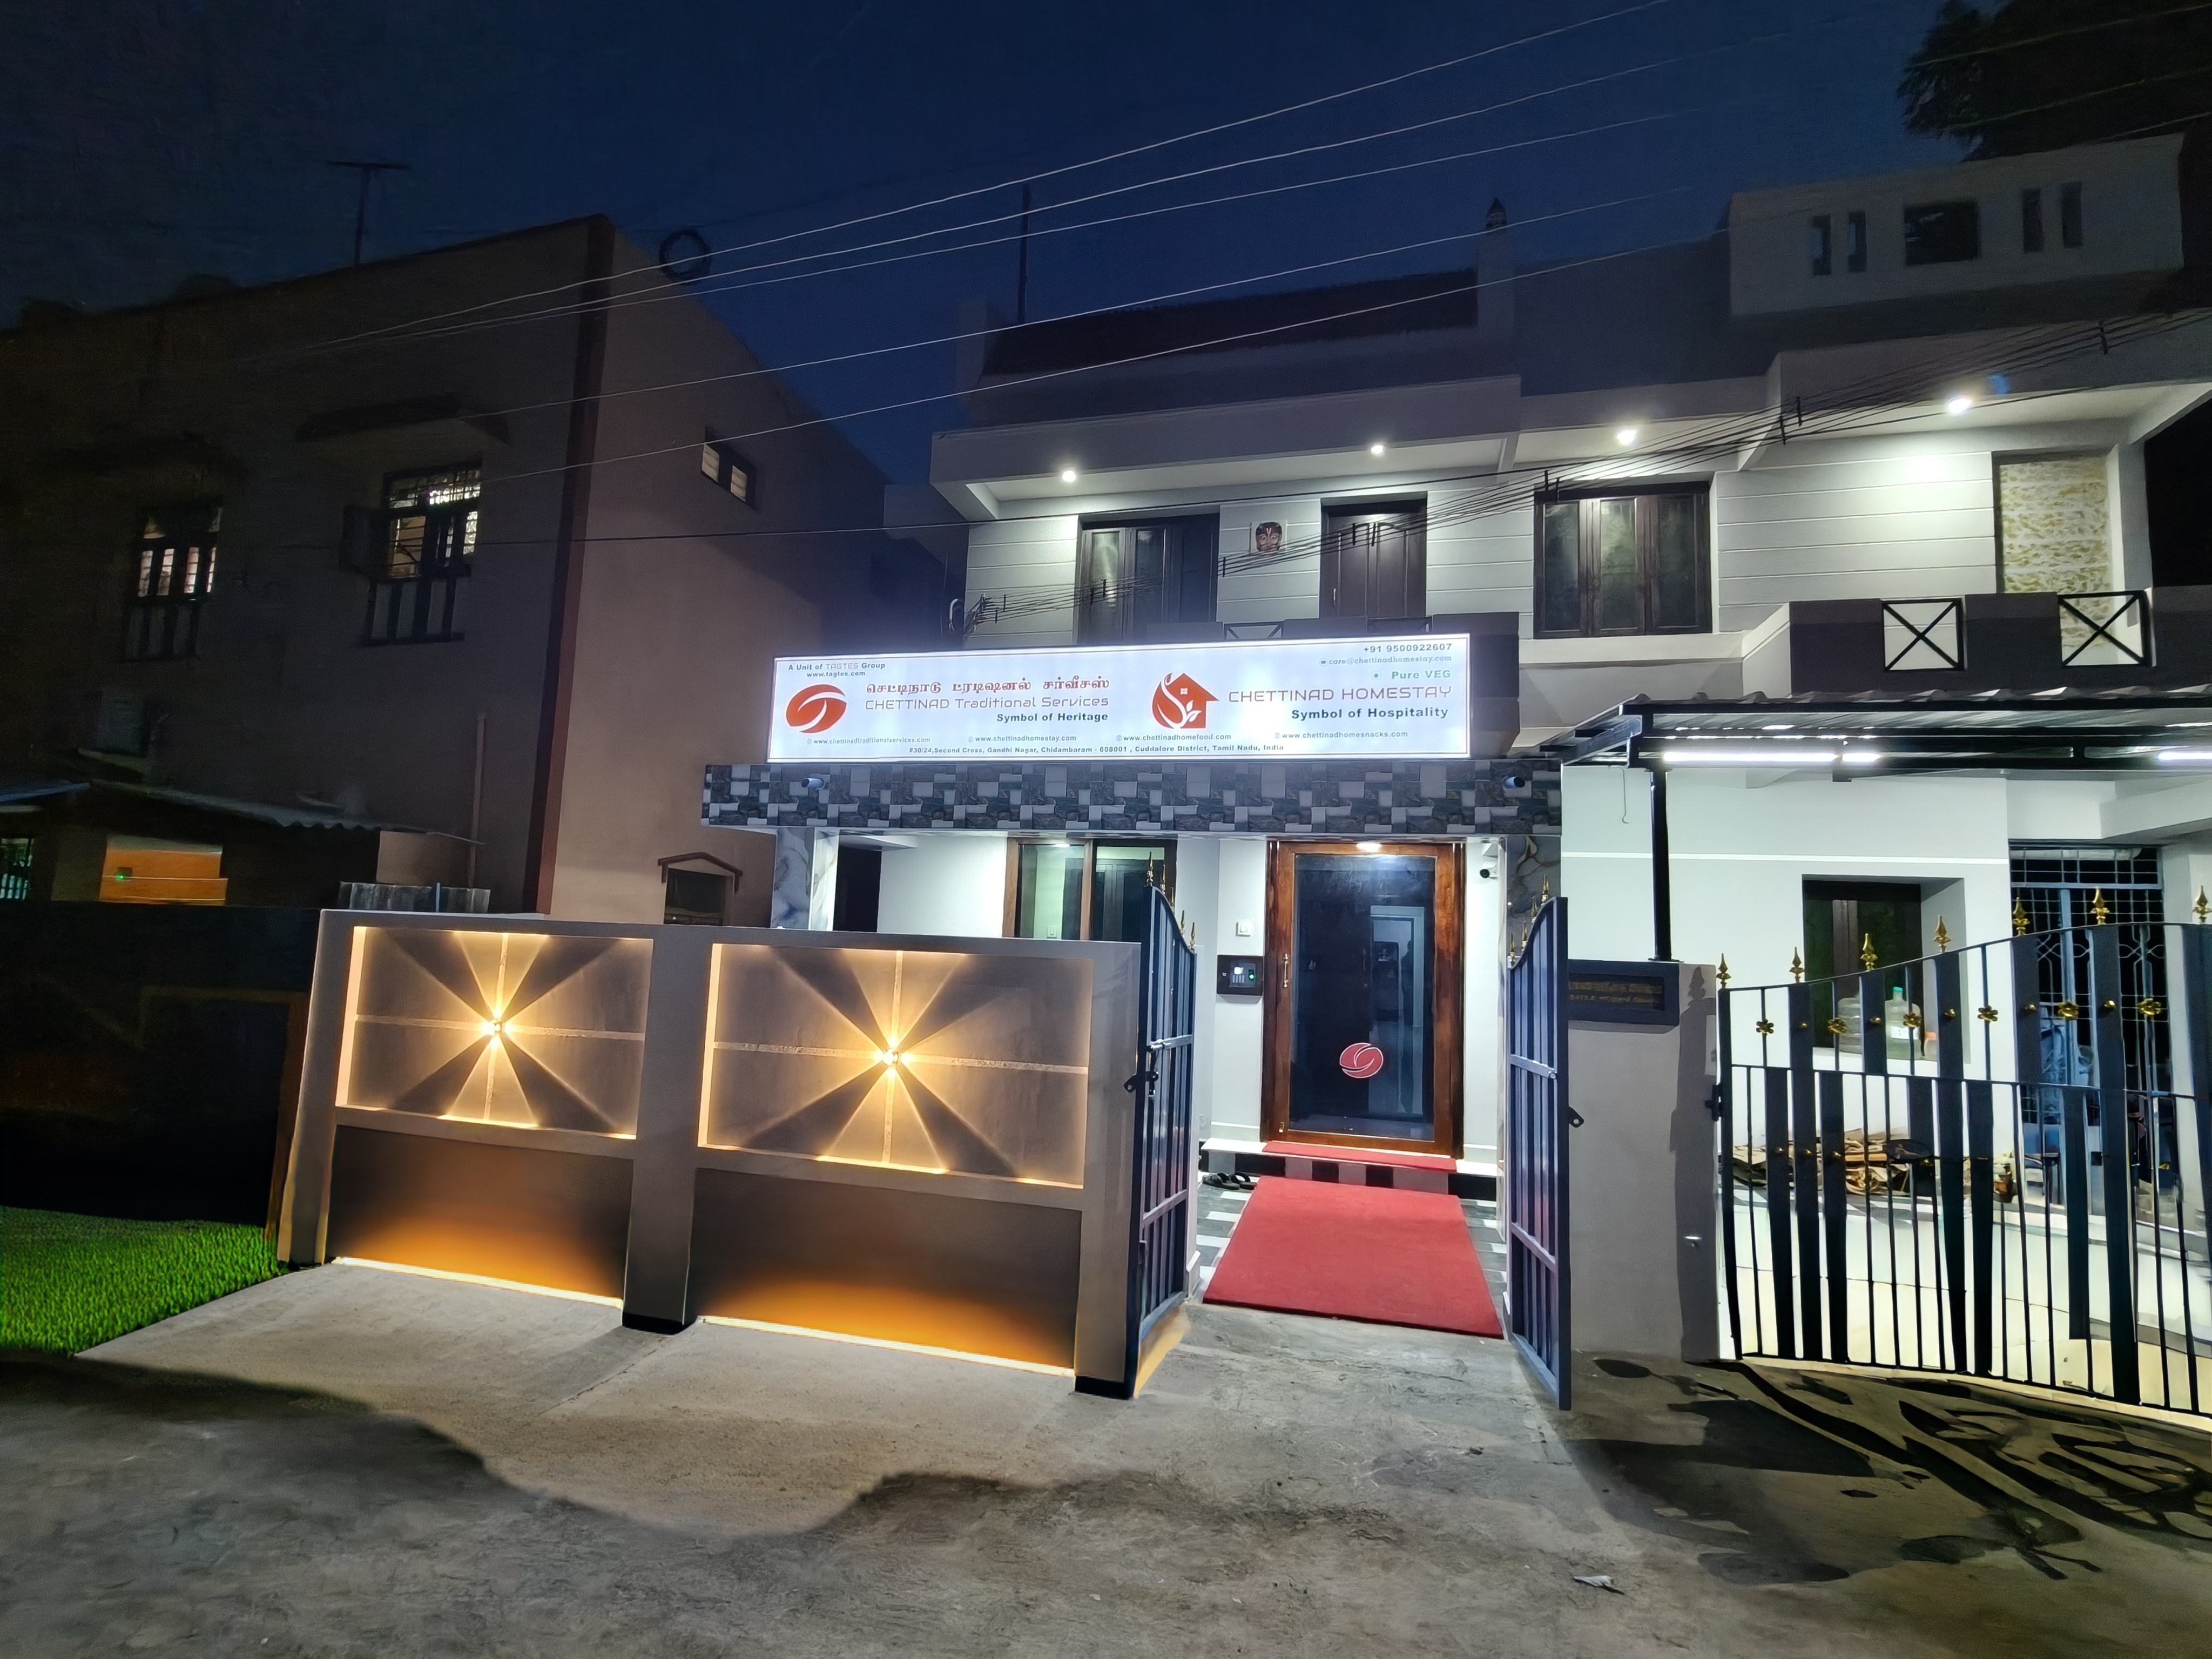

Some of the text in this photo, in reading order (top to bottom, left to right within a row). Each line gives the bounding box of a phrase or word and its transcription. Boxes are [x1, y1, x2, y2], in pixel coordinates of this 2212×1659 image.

[1386, 643, 1452, 652] 9500922607
[1425, 670, 1451, 678] VEG
[1228, 686, 1452, 702] CHETTINAD HOMESTAY
[865, 696, 1109, 710] CHETTINAD Traditional Services
[997, 712, 1108, 723] Symbol of Heritage
[1291, 707, 1448, 721] Symbol of Hospitality
